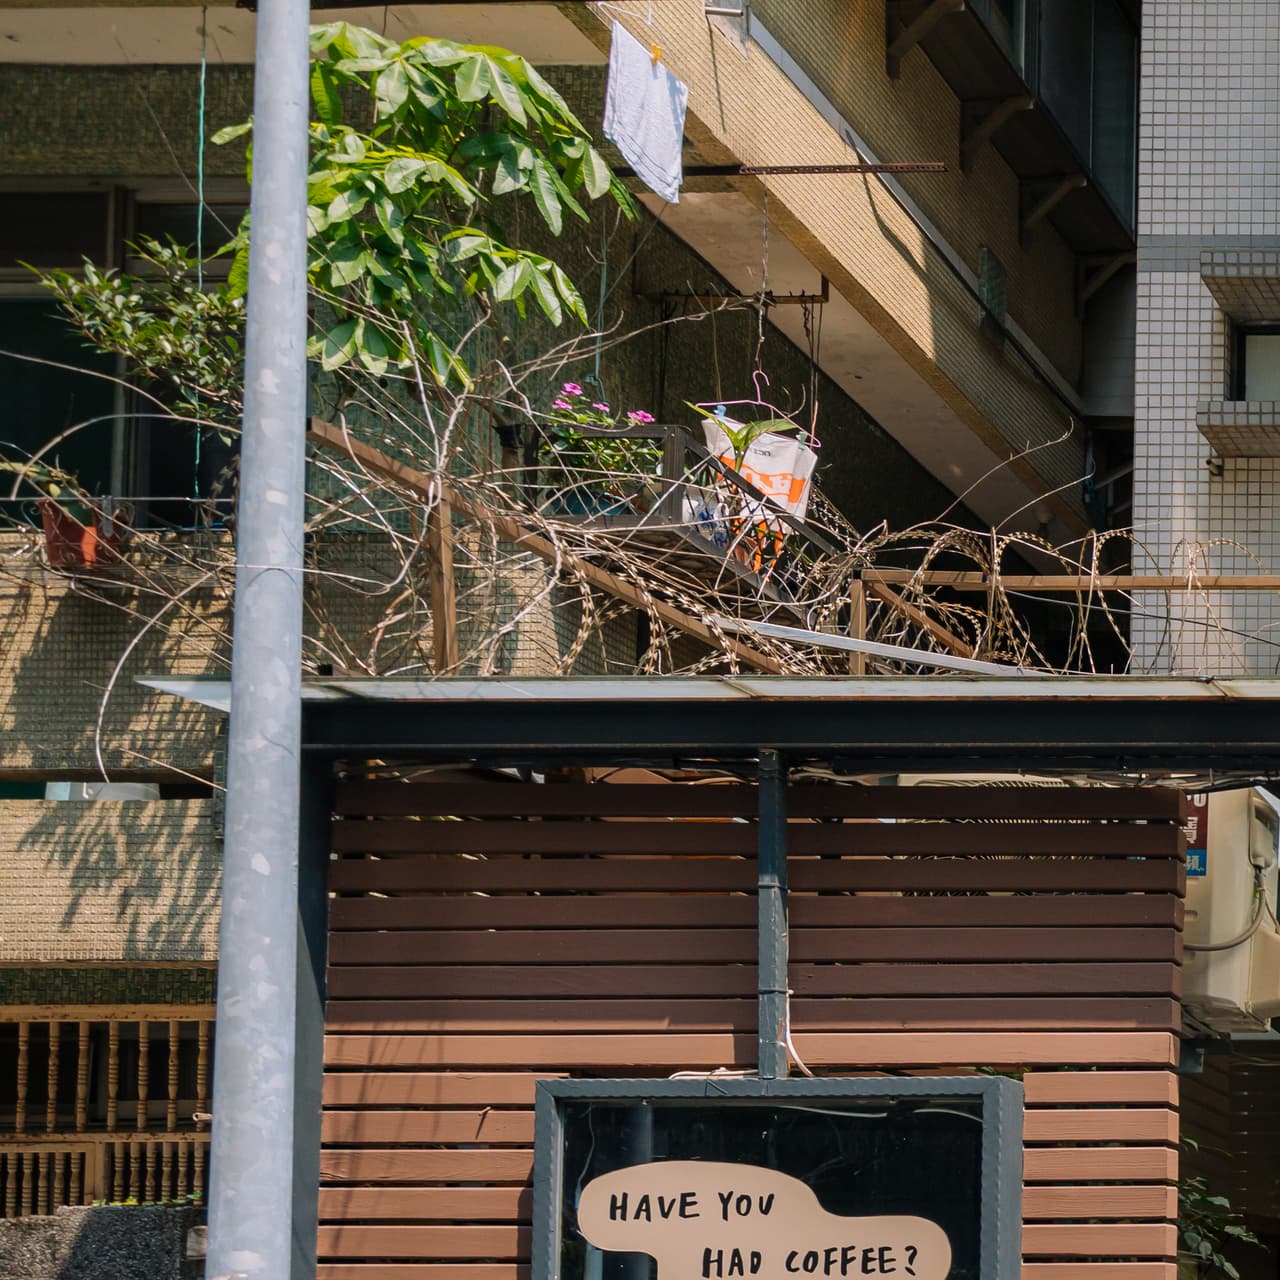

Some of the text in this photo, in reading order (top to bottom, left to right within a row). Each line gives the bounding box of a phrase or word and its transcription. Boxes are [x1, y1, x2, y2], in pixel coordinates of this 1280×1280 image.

[609, 1191, 775, 1221] HAVE YOU
[702, 1245, 919, 1278] HAD COFFEE?
